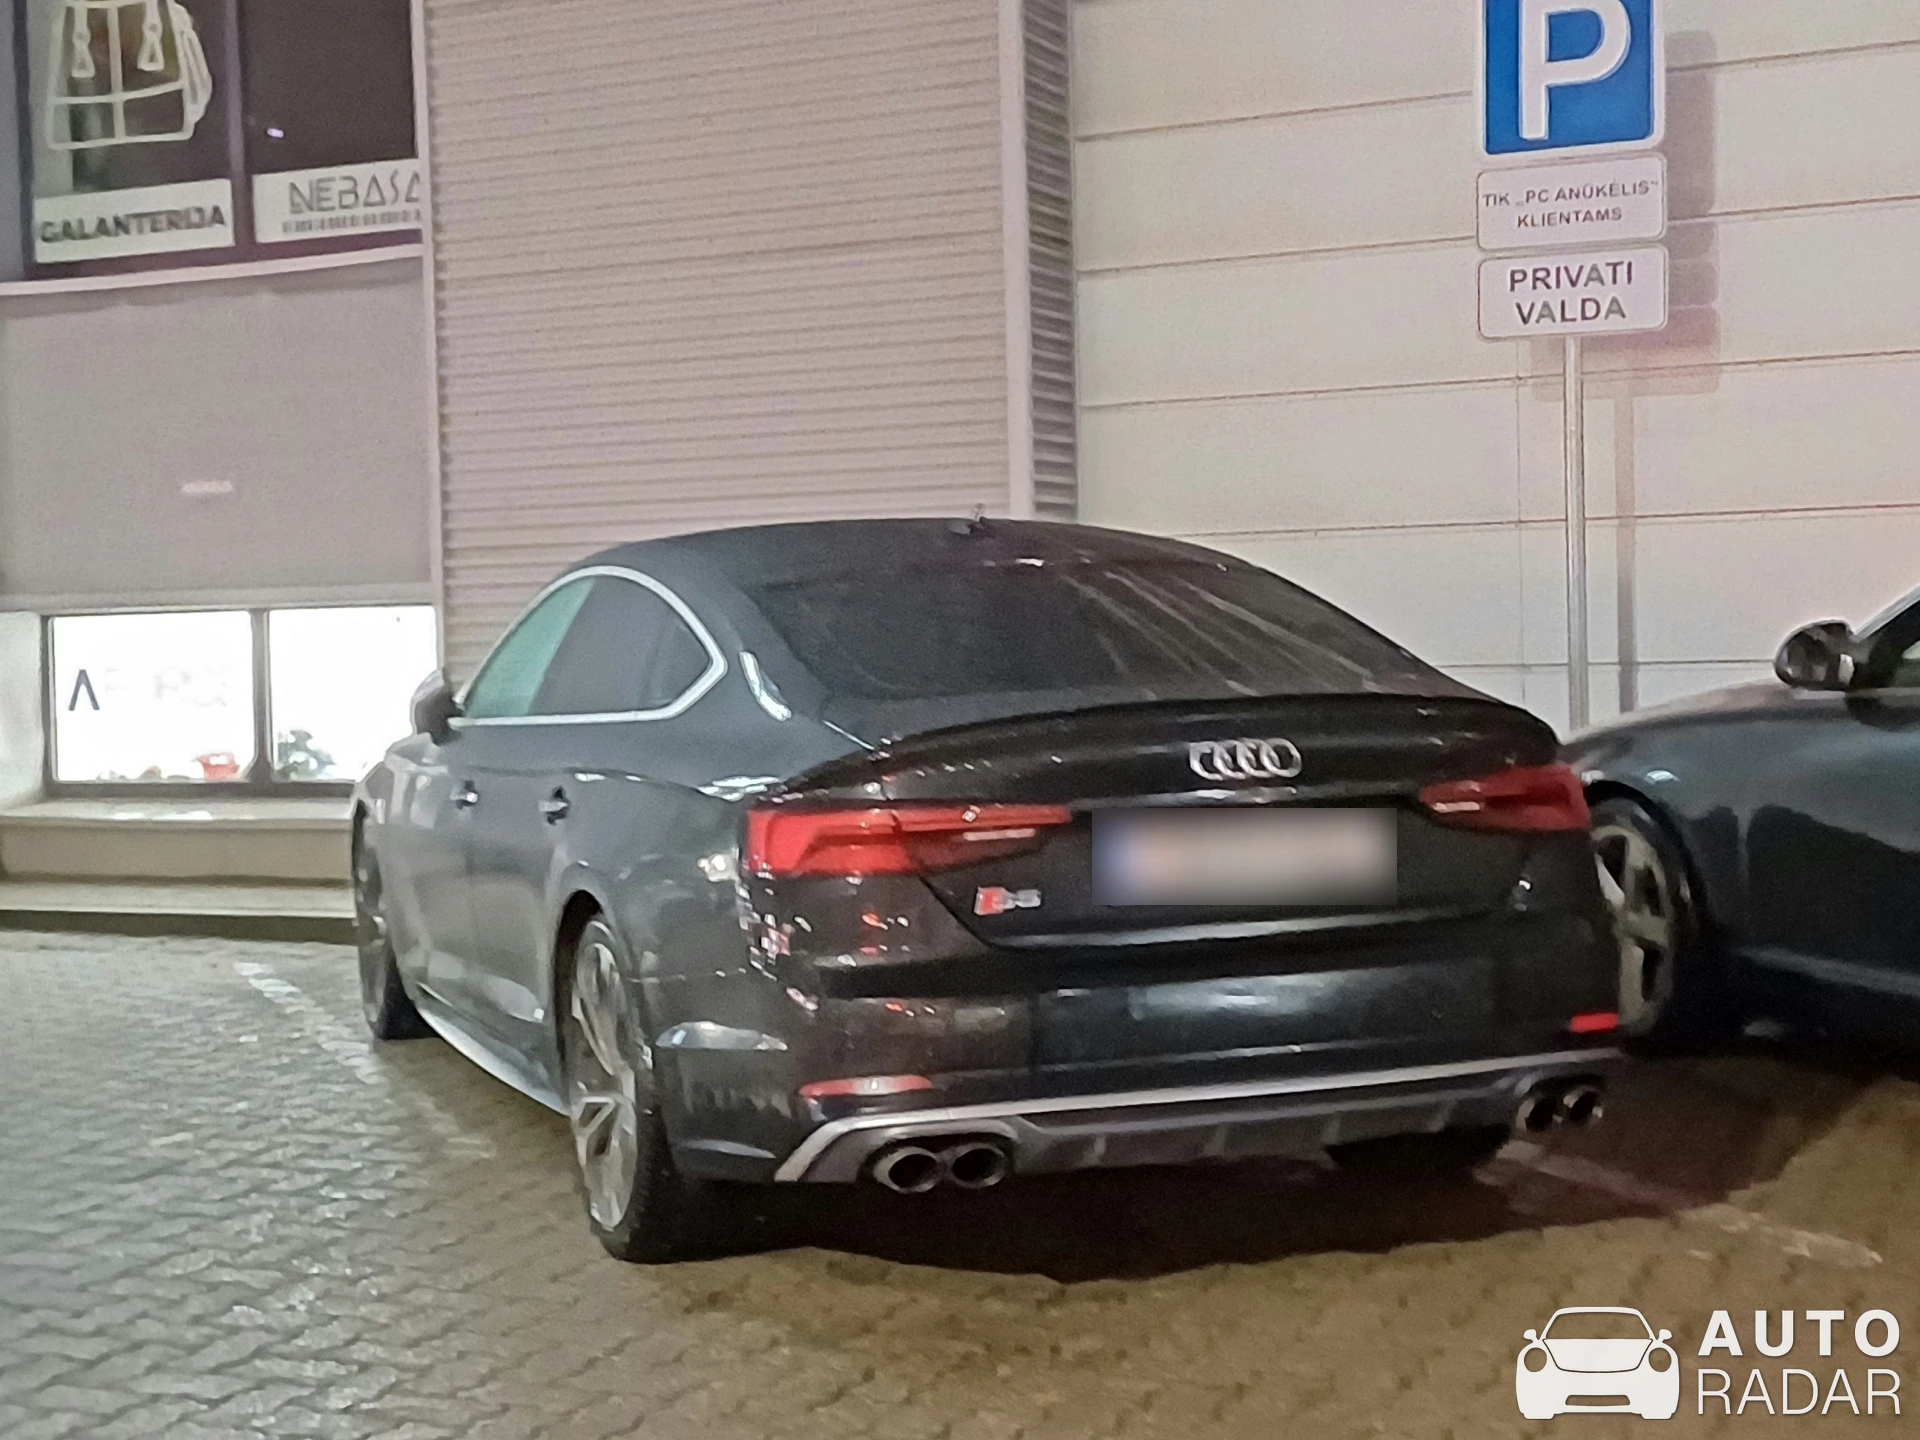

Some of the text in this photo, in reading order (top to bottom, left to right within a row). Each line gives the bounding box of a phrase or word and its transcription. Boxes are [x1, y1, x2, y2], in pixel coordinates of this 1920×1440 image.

[1520, 0, 1631, 140] P
[1482, 192, 1510, 207] TIK
[1517, 207, 1622, 228] KLIENTAMS
[1509, 261, 1633, 292] PRIVATI
[1515, 296, 1627, 325] VALDA
